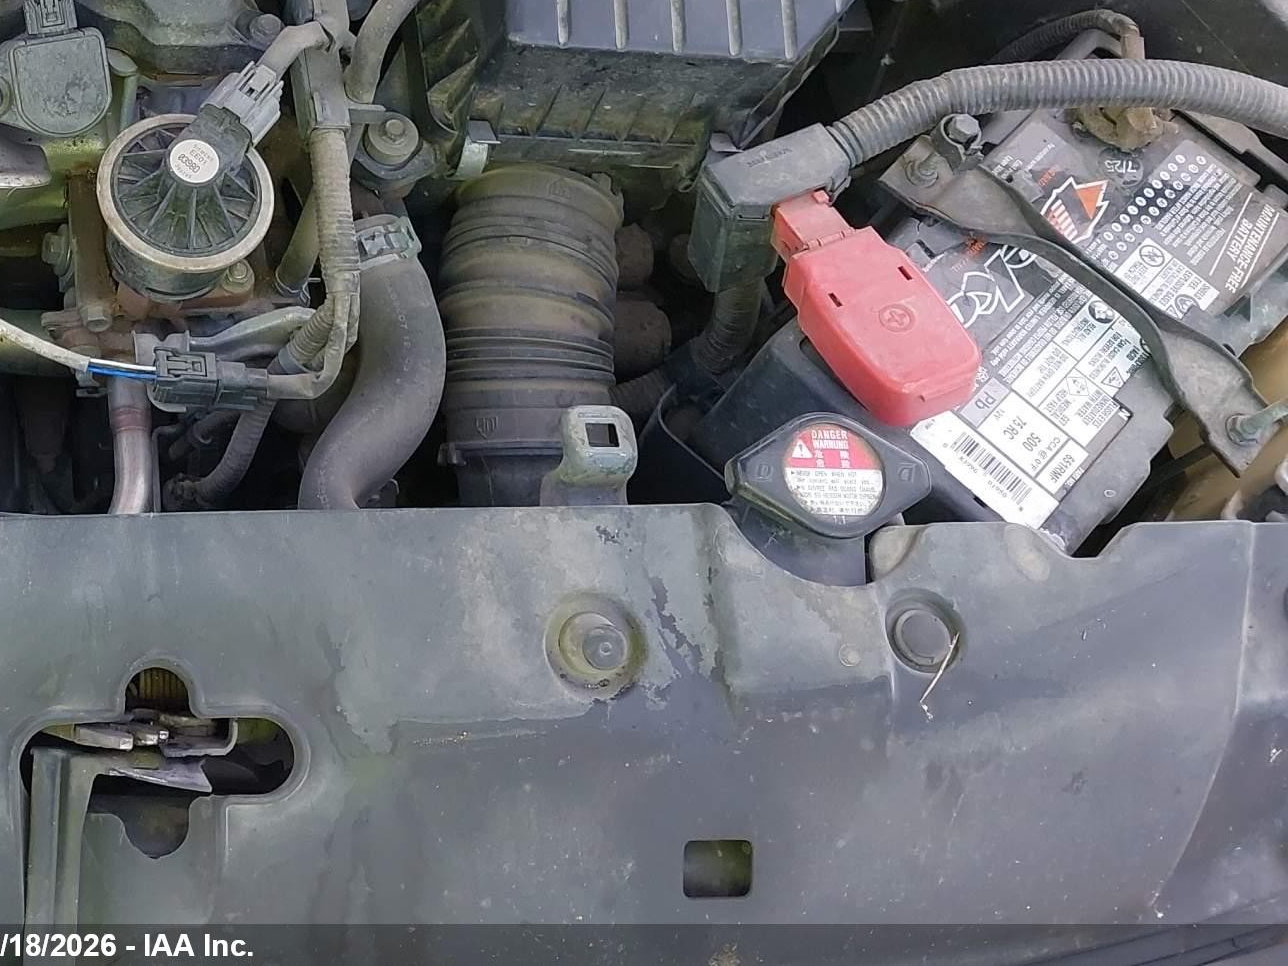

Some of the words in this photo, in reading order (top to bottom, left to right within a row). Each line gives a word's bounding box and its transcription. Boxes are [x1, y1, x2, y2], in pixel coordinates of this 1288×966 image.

[1103, 158, 1136, 174] 7/25
[1224, 217, 1253, 261] BATTERY
[1223, 203, 1276, 293] MAINTENANCE-FREE
[973, 390, 996, 413] Pb
[1010, 414, 1027, 430] 75
[811, 429, 847, 439] DANGER
[1001, 423, 1019, 441] RC
[812, 439, 848, 449] WARNUNG
[1020, 431, 1041, 452] 500
[1044, 435, 1061, 452] CCA
[1036, 449, 1049, 461] @
